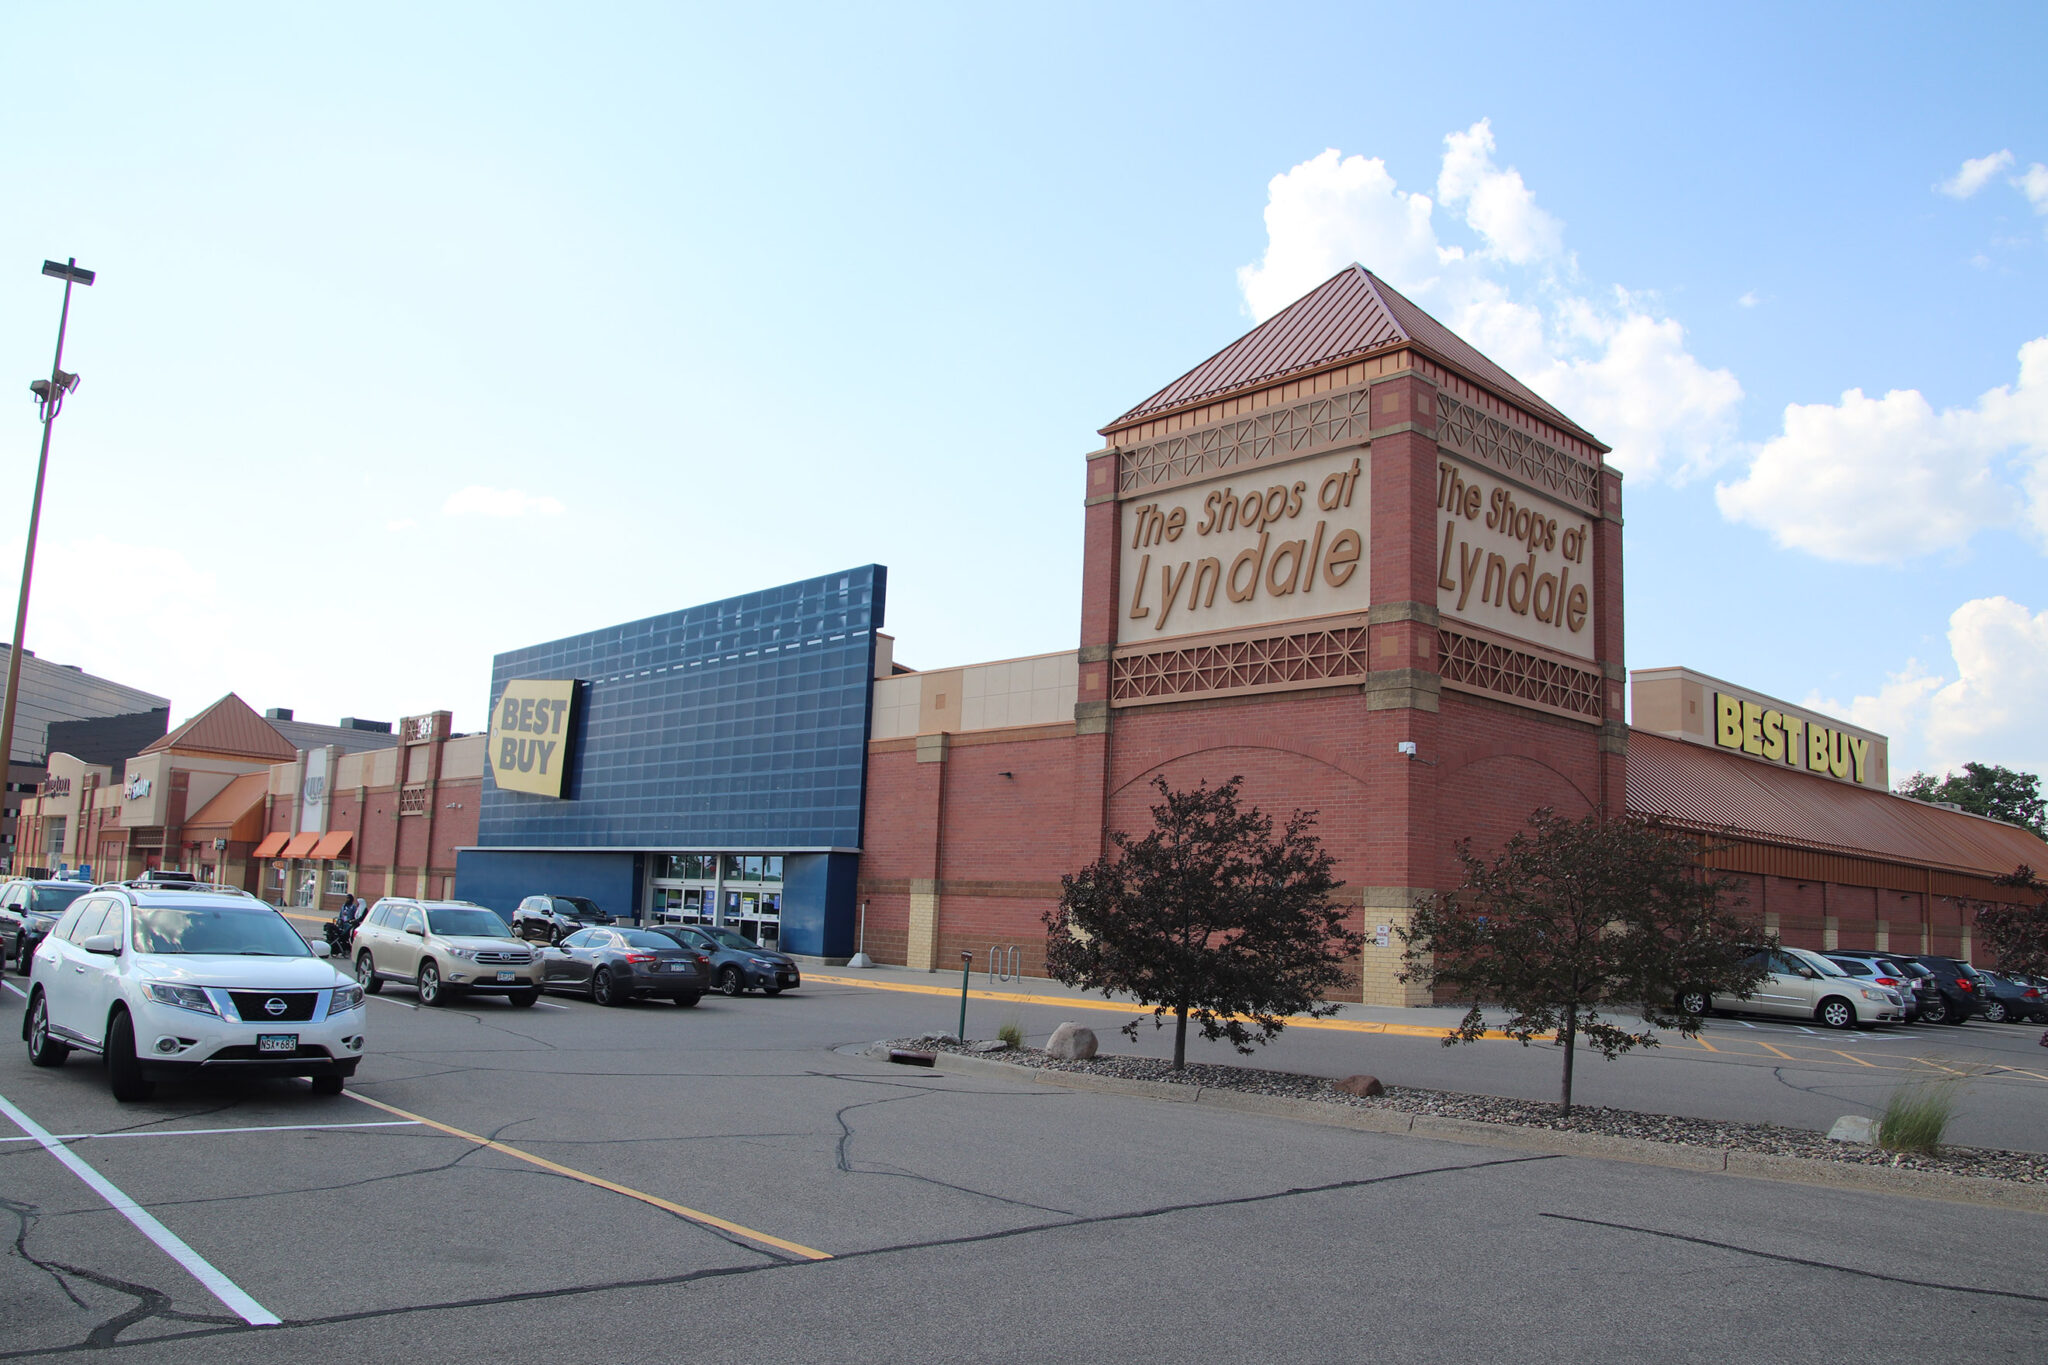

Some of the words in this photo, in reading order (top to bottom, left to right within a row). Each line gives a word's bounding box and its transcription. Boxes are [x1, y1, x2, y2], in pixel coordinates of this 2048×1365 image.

[1132, 503, 1186, 549] The
[1197, 481, 1306, 536] Shops
[1317, 458, 1360, 511] at
[1438, 461, 1482, 520] The
[1486, 487, 1557, 553] Shops
[1562, 524, 1587, 564] at
[1130, 520, 1361, 630] Lyndale
[1438, 520, 1588, 633] Lyndale
[499, 737, 557, 775] BUY
[501, 698, 567, 735] BEST
[1714, 692, 1802, 765] BEST
[1805, 722, 1870, 783] BUY
